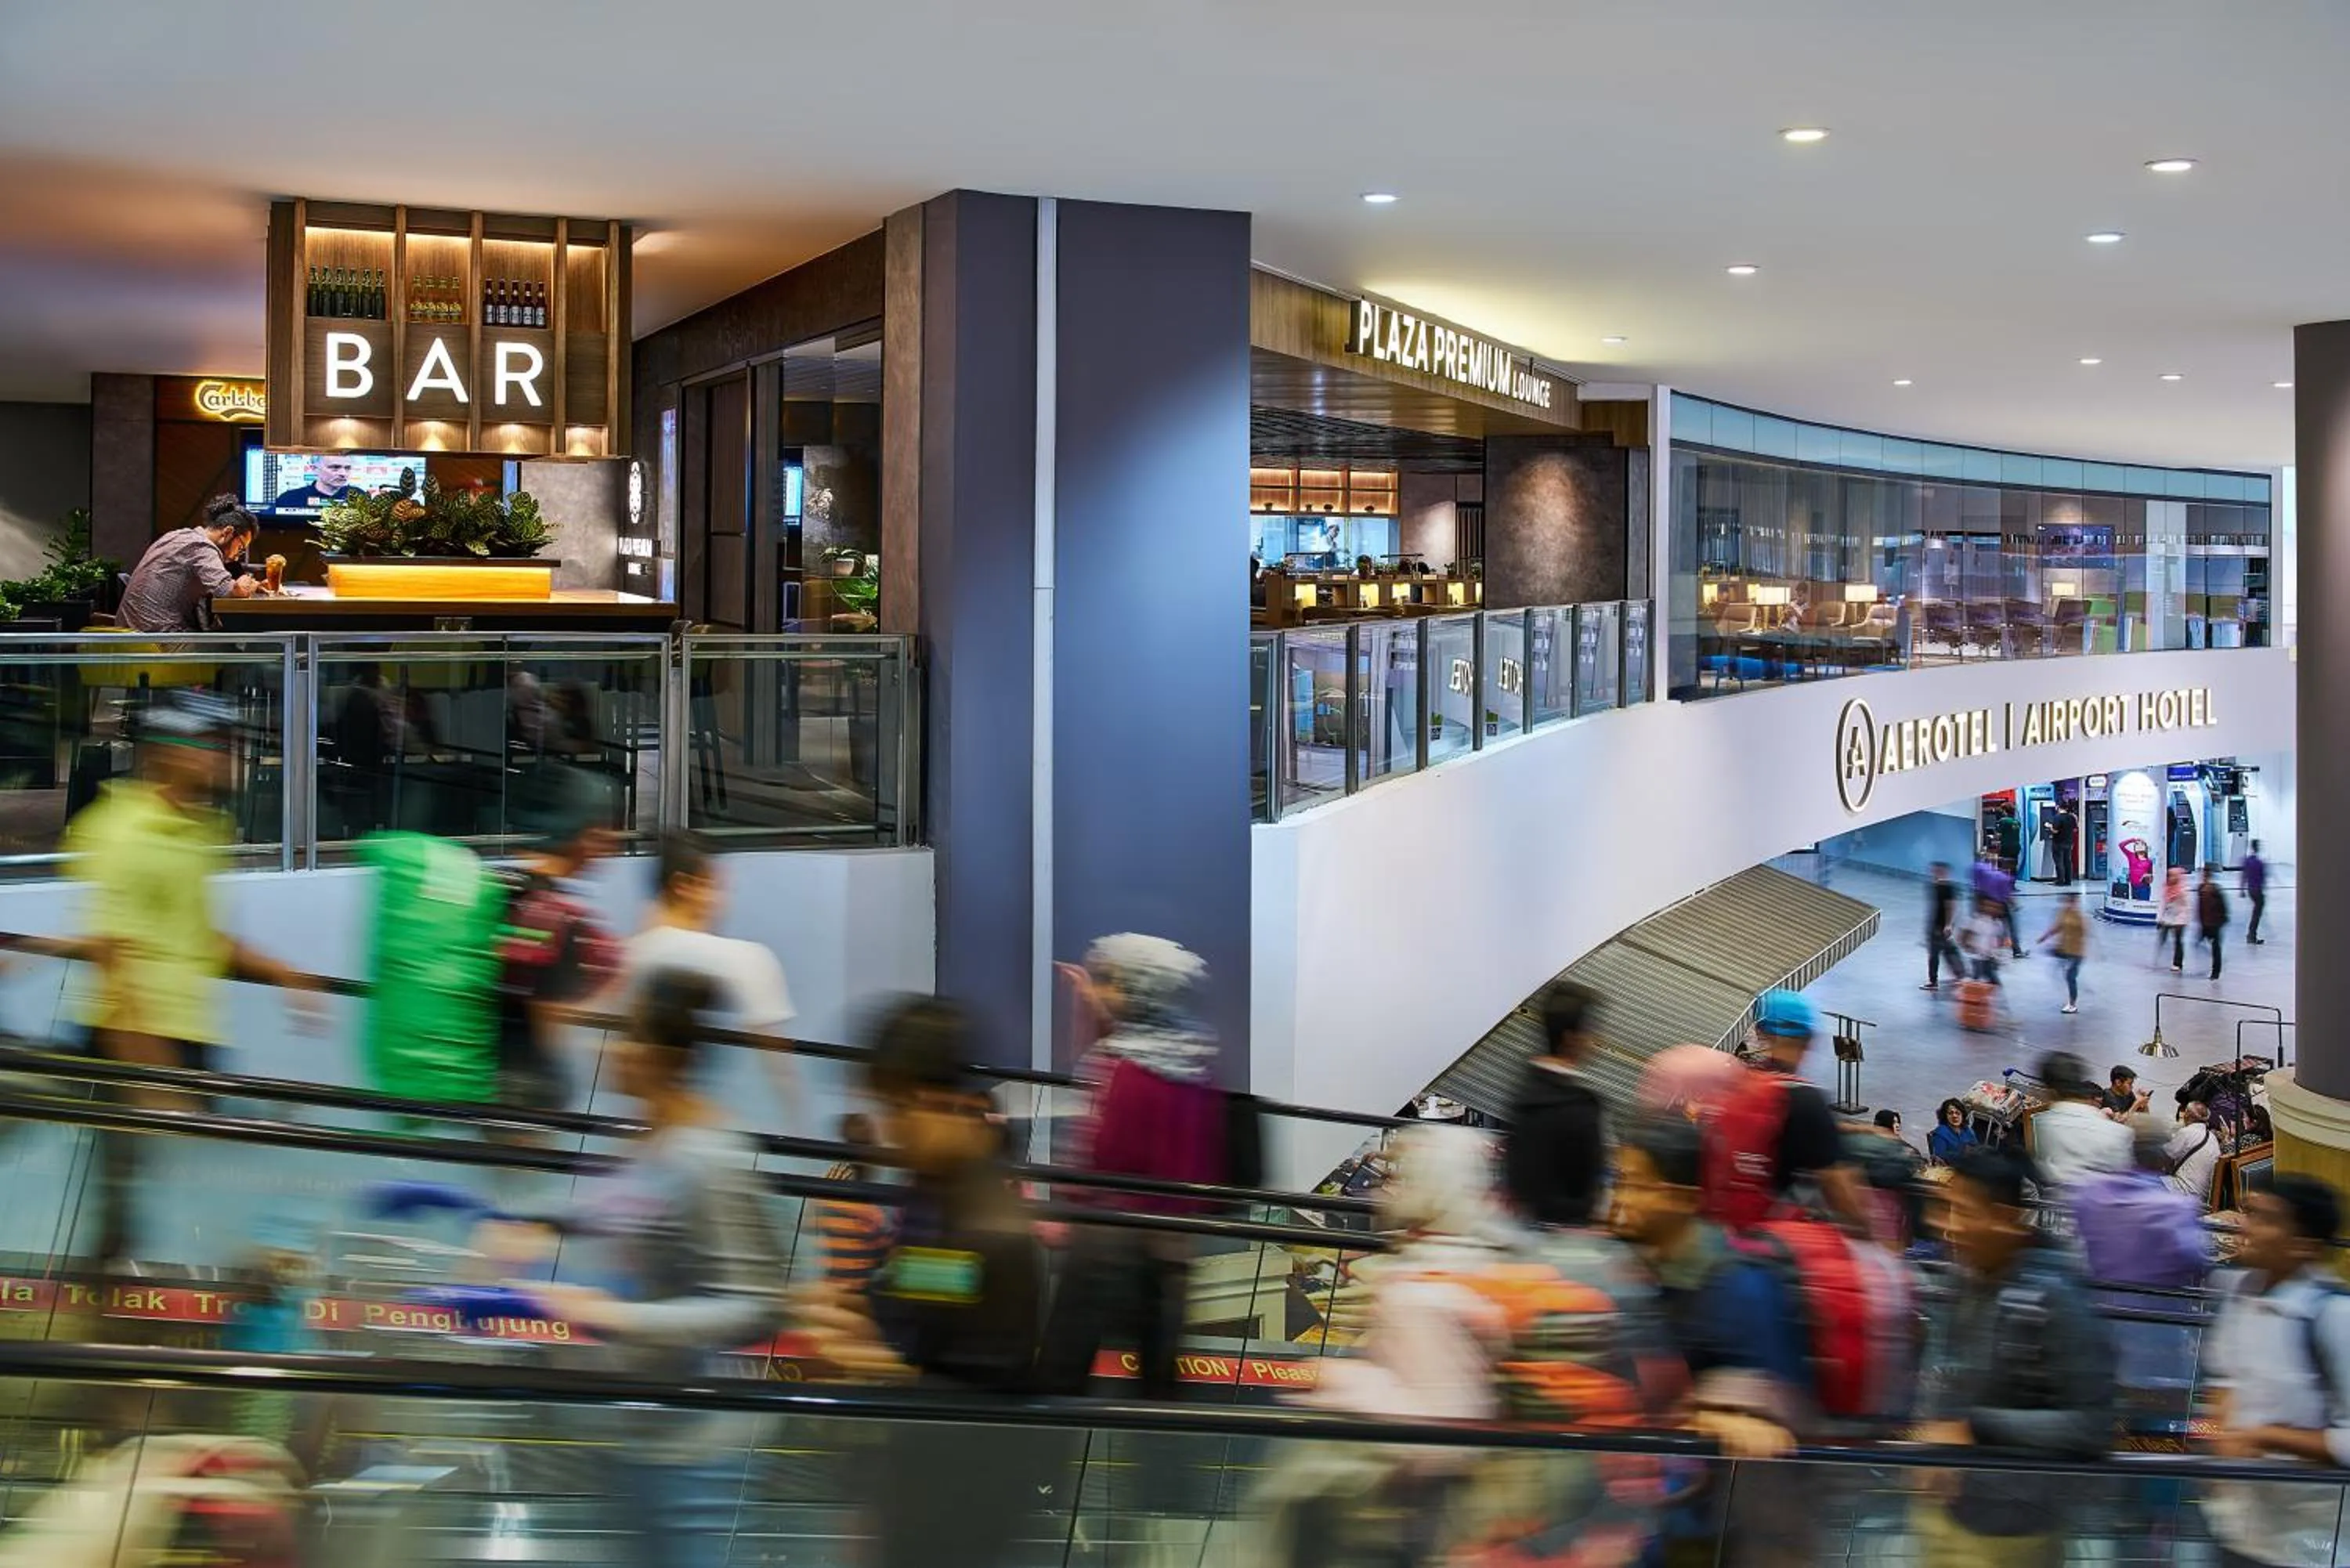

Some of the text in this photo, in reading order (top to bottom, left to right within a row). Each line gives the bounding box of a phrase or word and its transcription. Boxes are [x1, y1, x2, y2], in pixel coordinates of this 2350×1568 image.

[325, 332, 544, 406] BAR
[1358, 298, 1551, 408] PLAZA PREMIUM LOUNGE
[1878, 708, 1998, 775] AEROTEL
[2021, 694, 2132, 746] AIRPORT
[2138, 688, 2218, 732] HOTEL
[63, 1284, 167, 1311] Tolak
[304, 1300, 338, 1322] Di
